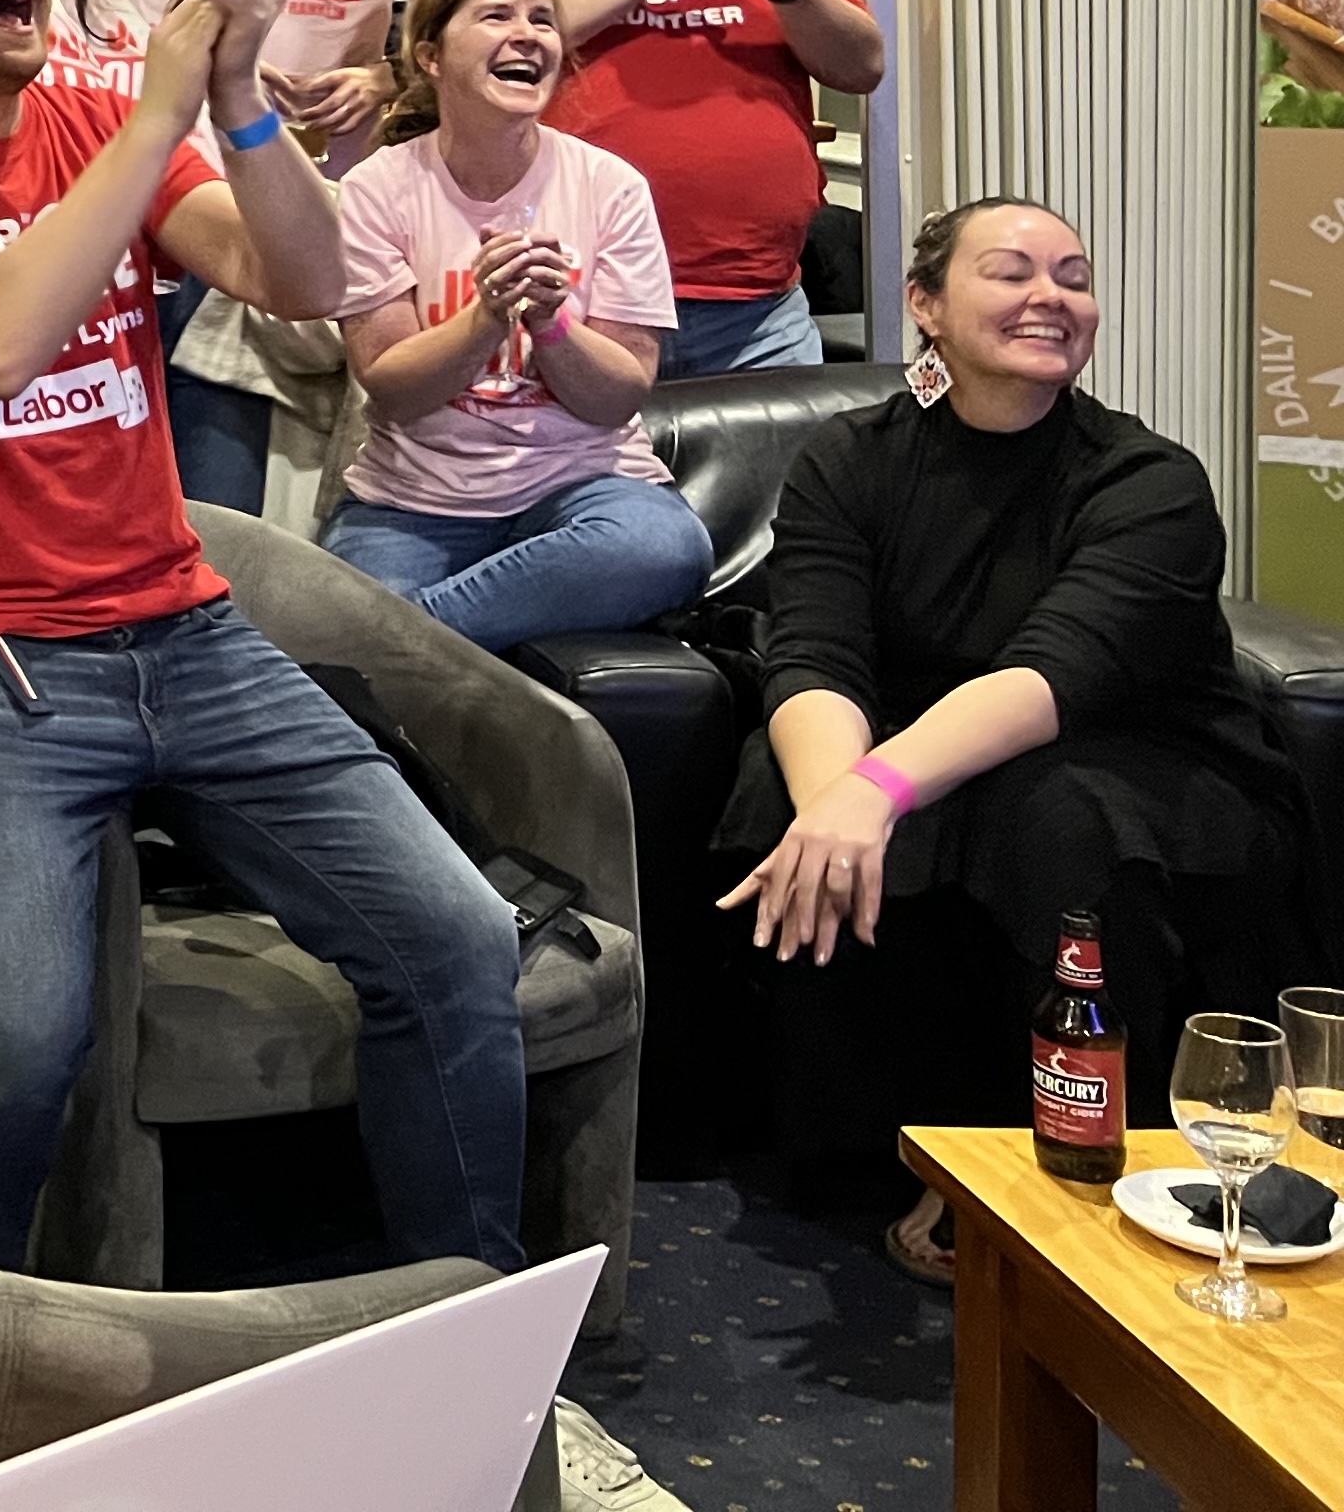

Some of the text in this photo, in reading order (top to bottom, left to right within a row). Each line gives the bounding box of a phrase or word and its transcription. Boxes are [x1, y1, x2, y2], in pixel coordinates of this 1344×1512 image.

[619, 5, 744, 30] UNTEER
[1261, 325, 1309, 427] DAILY
[3, 379, 106, 426] Labor
